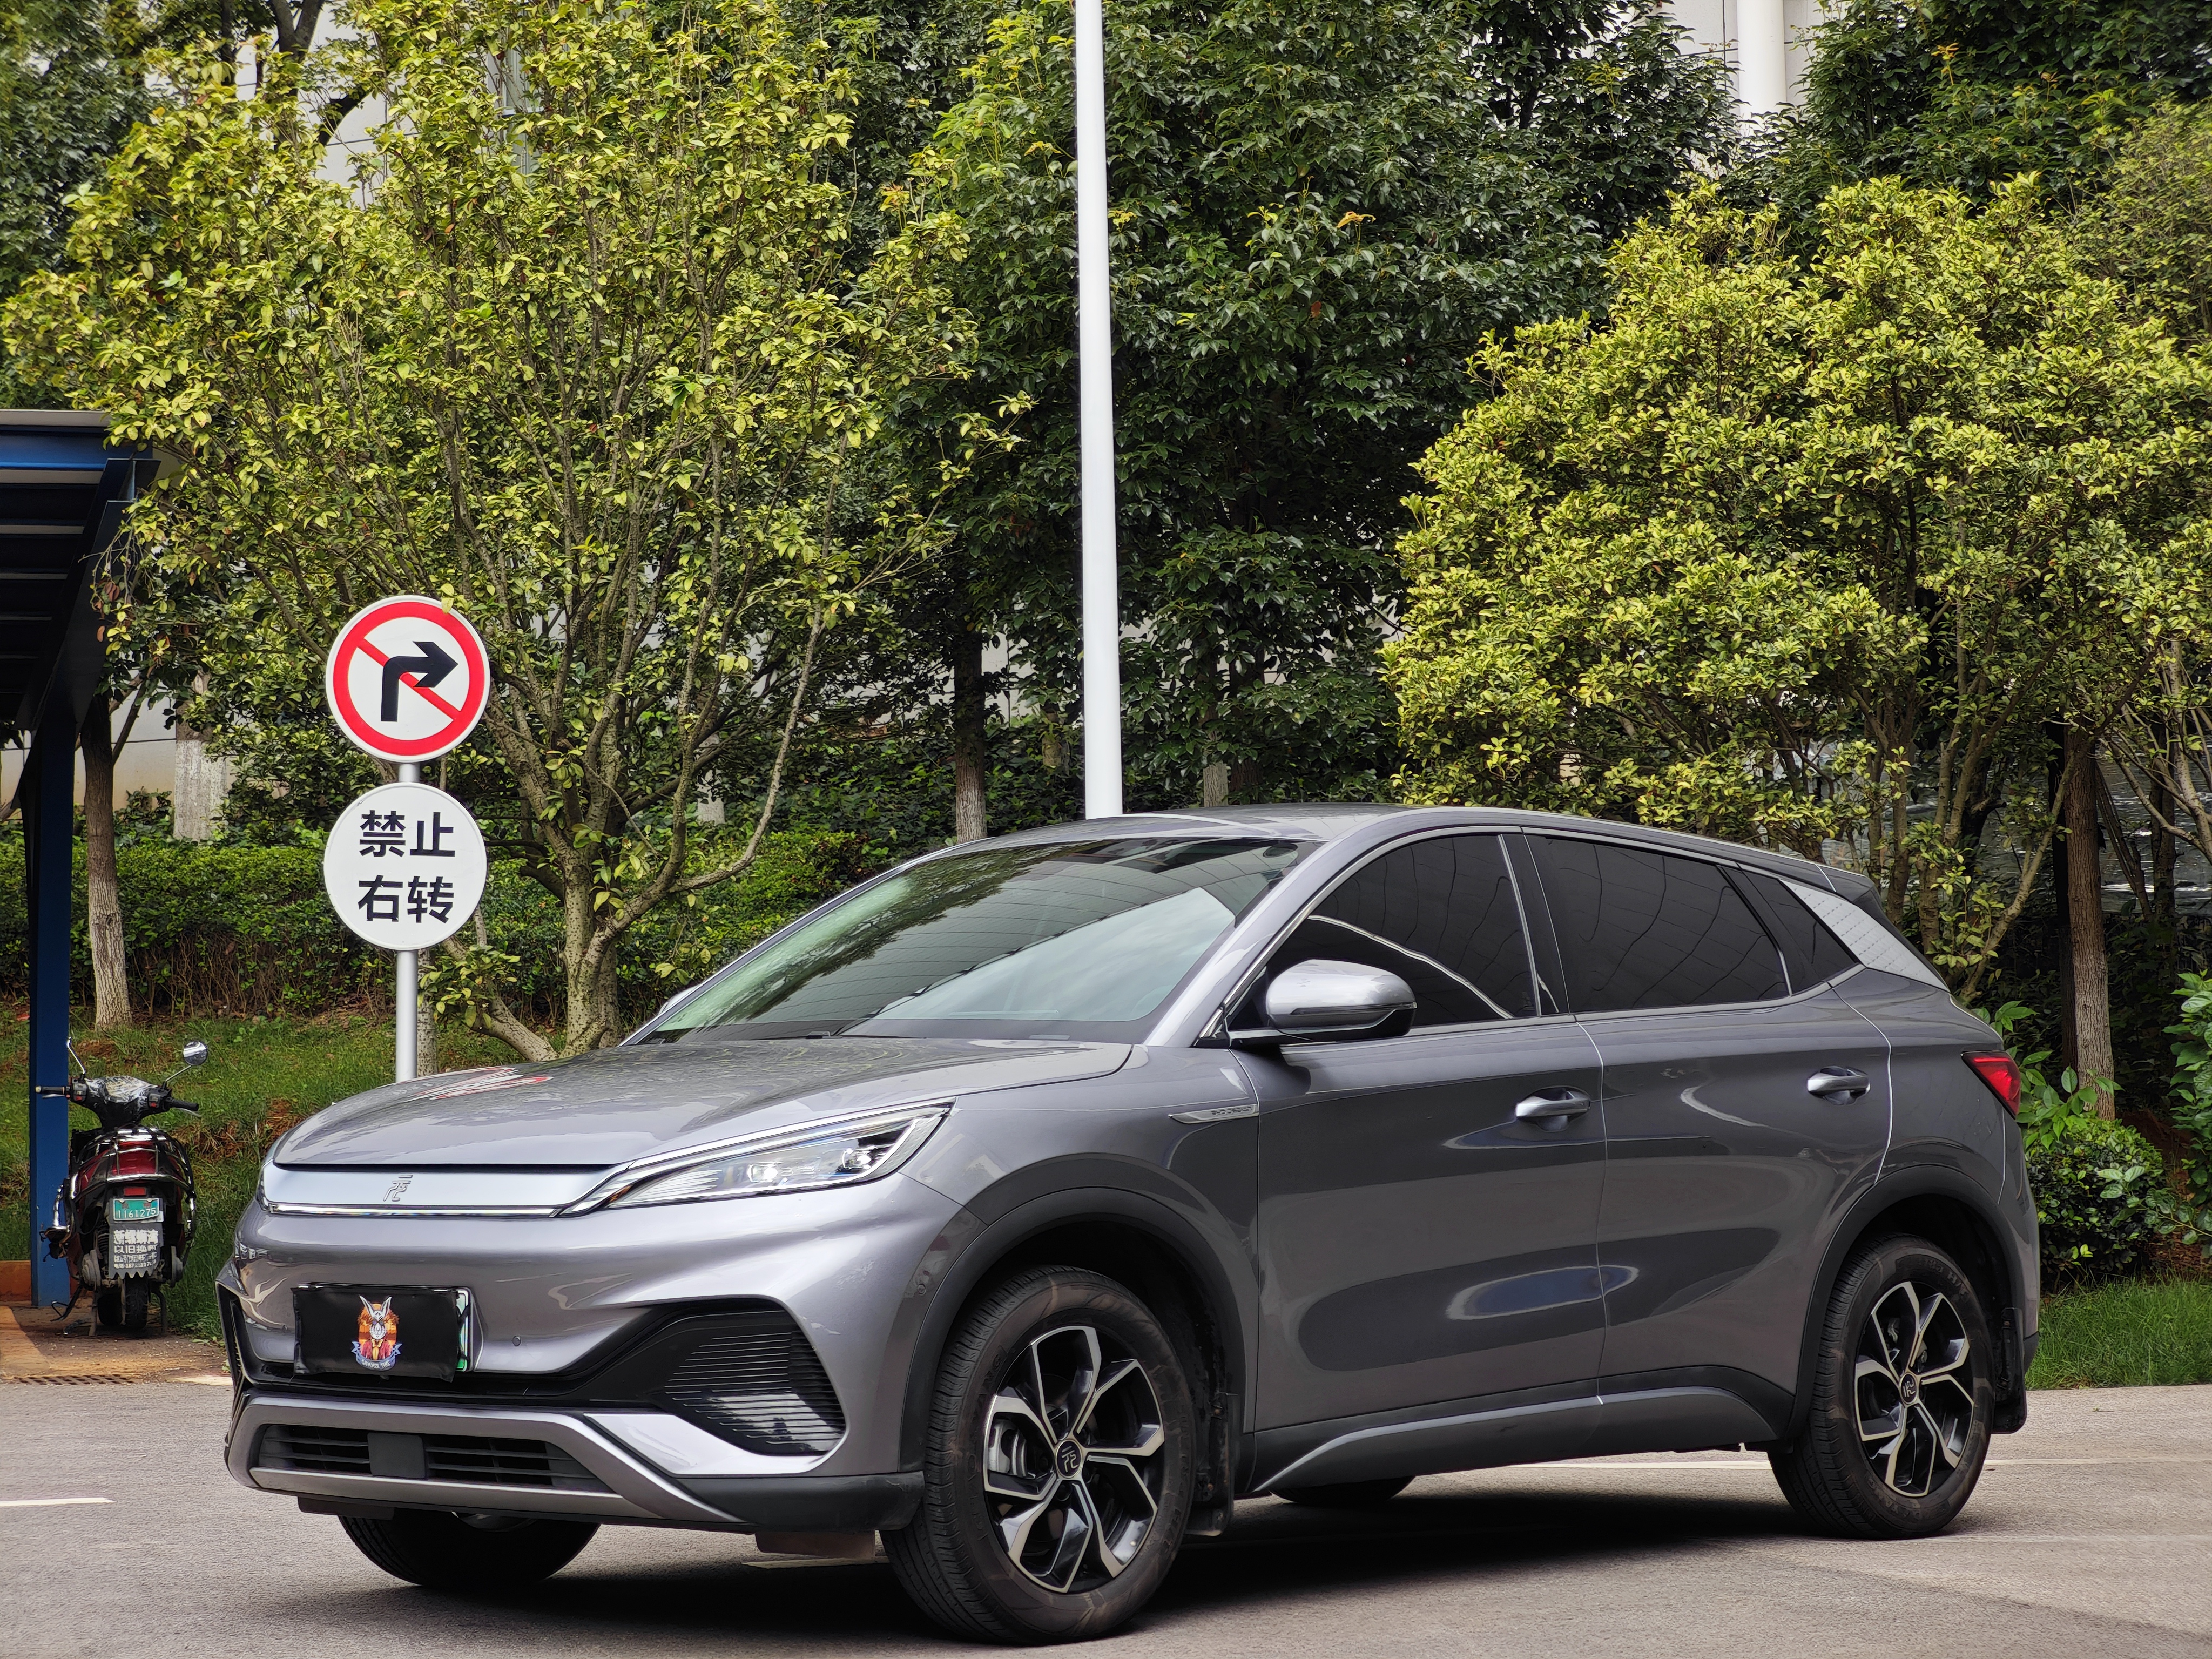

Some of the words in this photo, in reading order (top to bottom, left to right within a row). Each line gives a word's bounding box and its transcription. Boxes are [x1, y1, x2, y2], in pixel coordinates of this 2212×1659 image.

[359, 810, 456, 858] 禁止
[358, 874, 455, 924] 右转
[118, 1207, 156, 1218] 1161275
[361, 1359, 380, 1369] SUMMER
[380, 1360, 391, 1368] TIME
